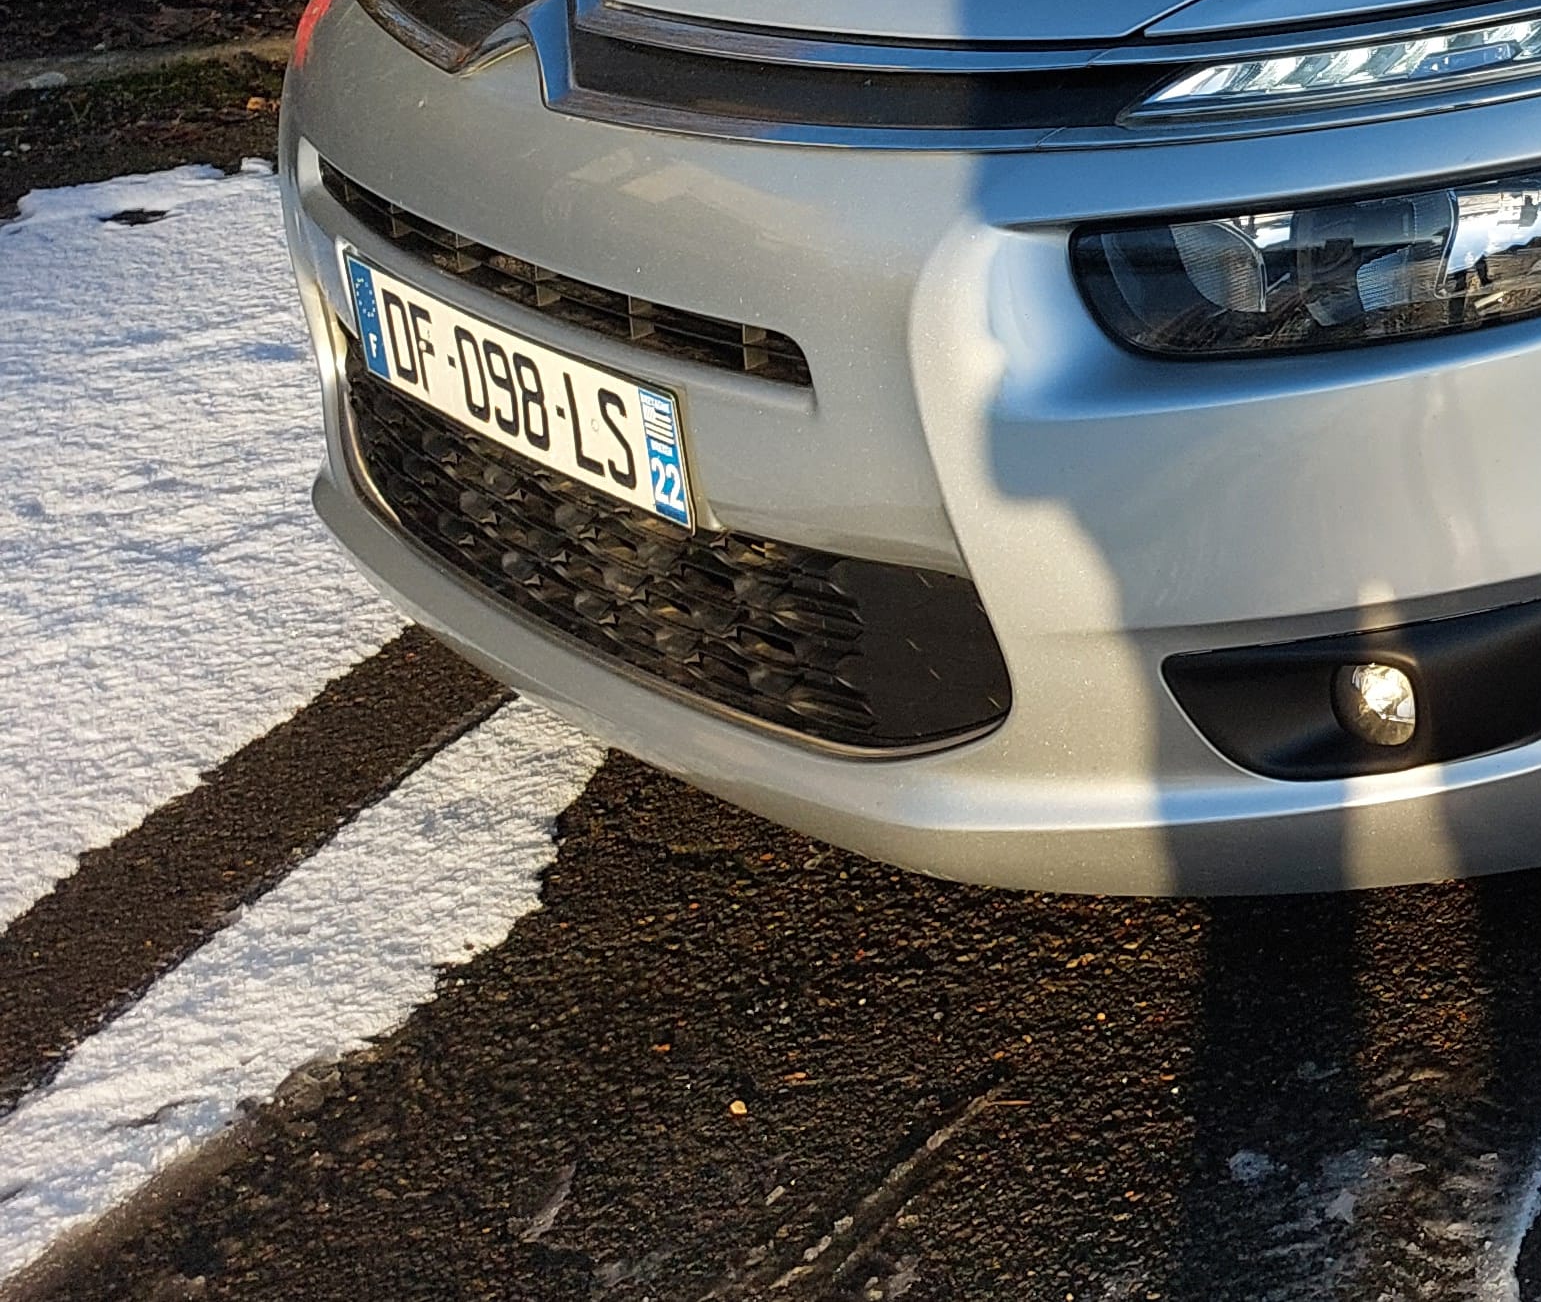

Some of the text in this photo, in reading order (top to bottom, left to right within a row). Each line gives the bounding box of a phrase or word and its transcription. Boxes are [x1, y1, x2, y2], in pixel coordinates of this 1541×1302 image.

[370, 333, 378, 359] F
[381, 288, 638, 491] DF-098-LS
[650, 456, 686, 512] 22
